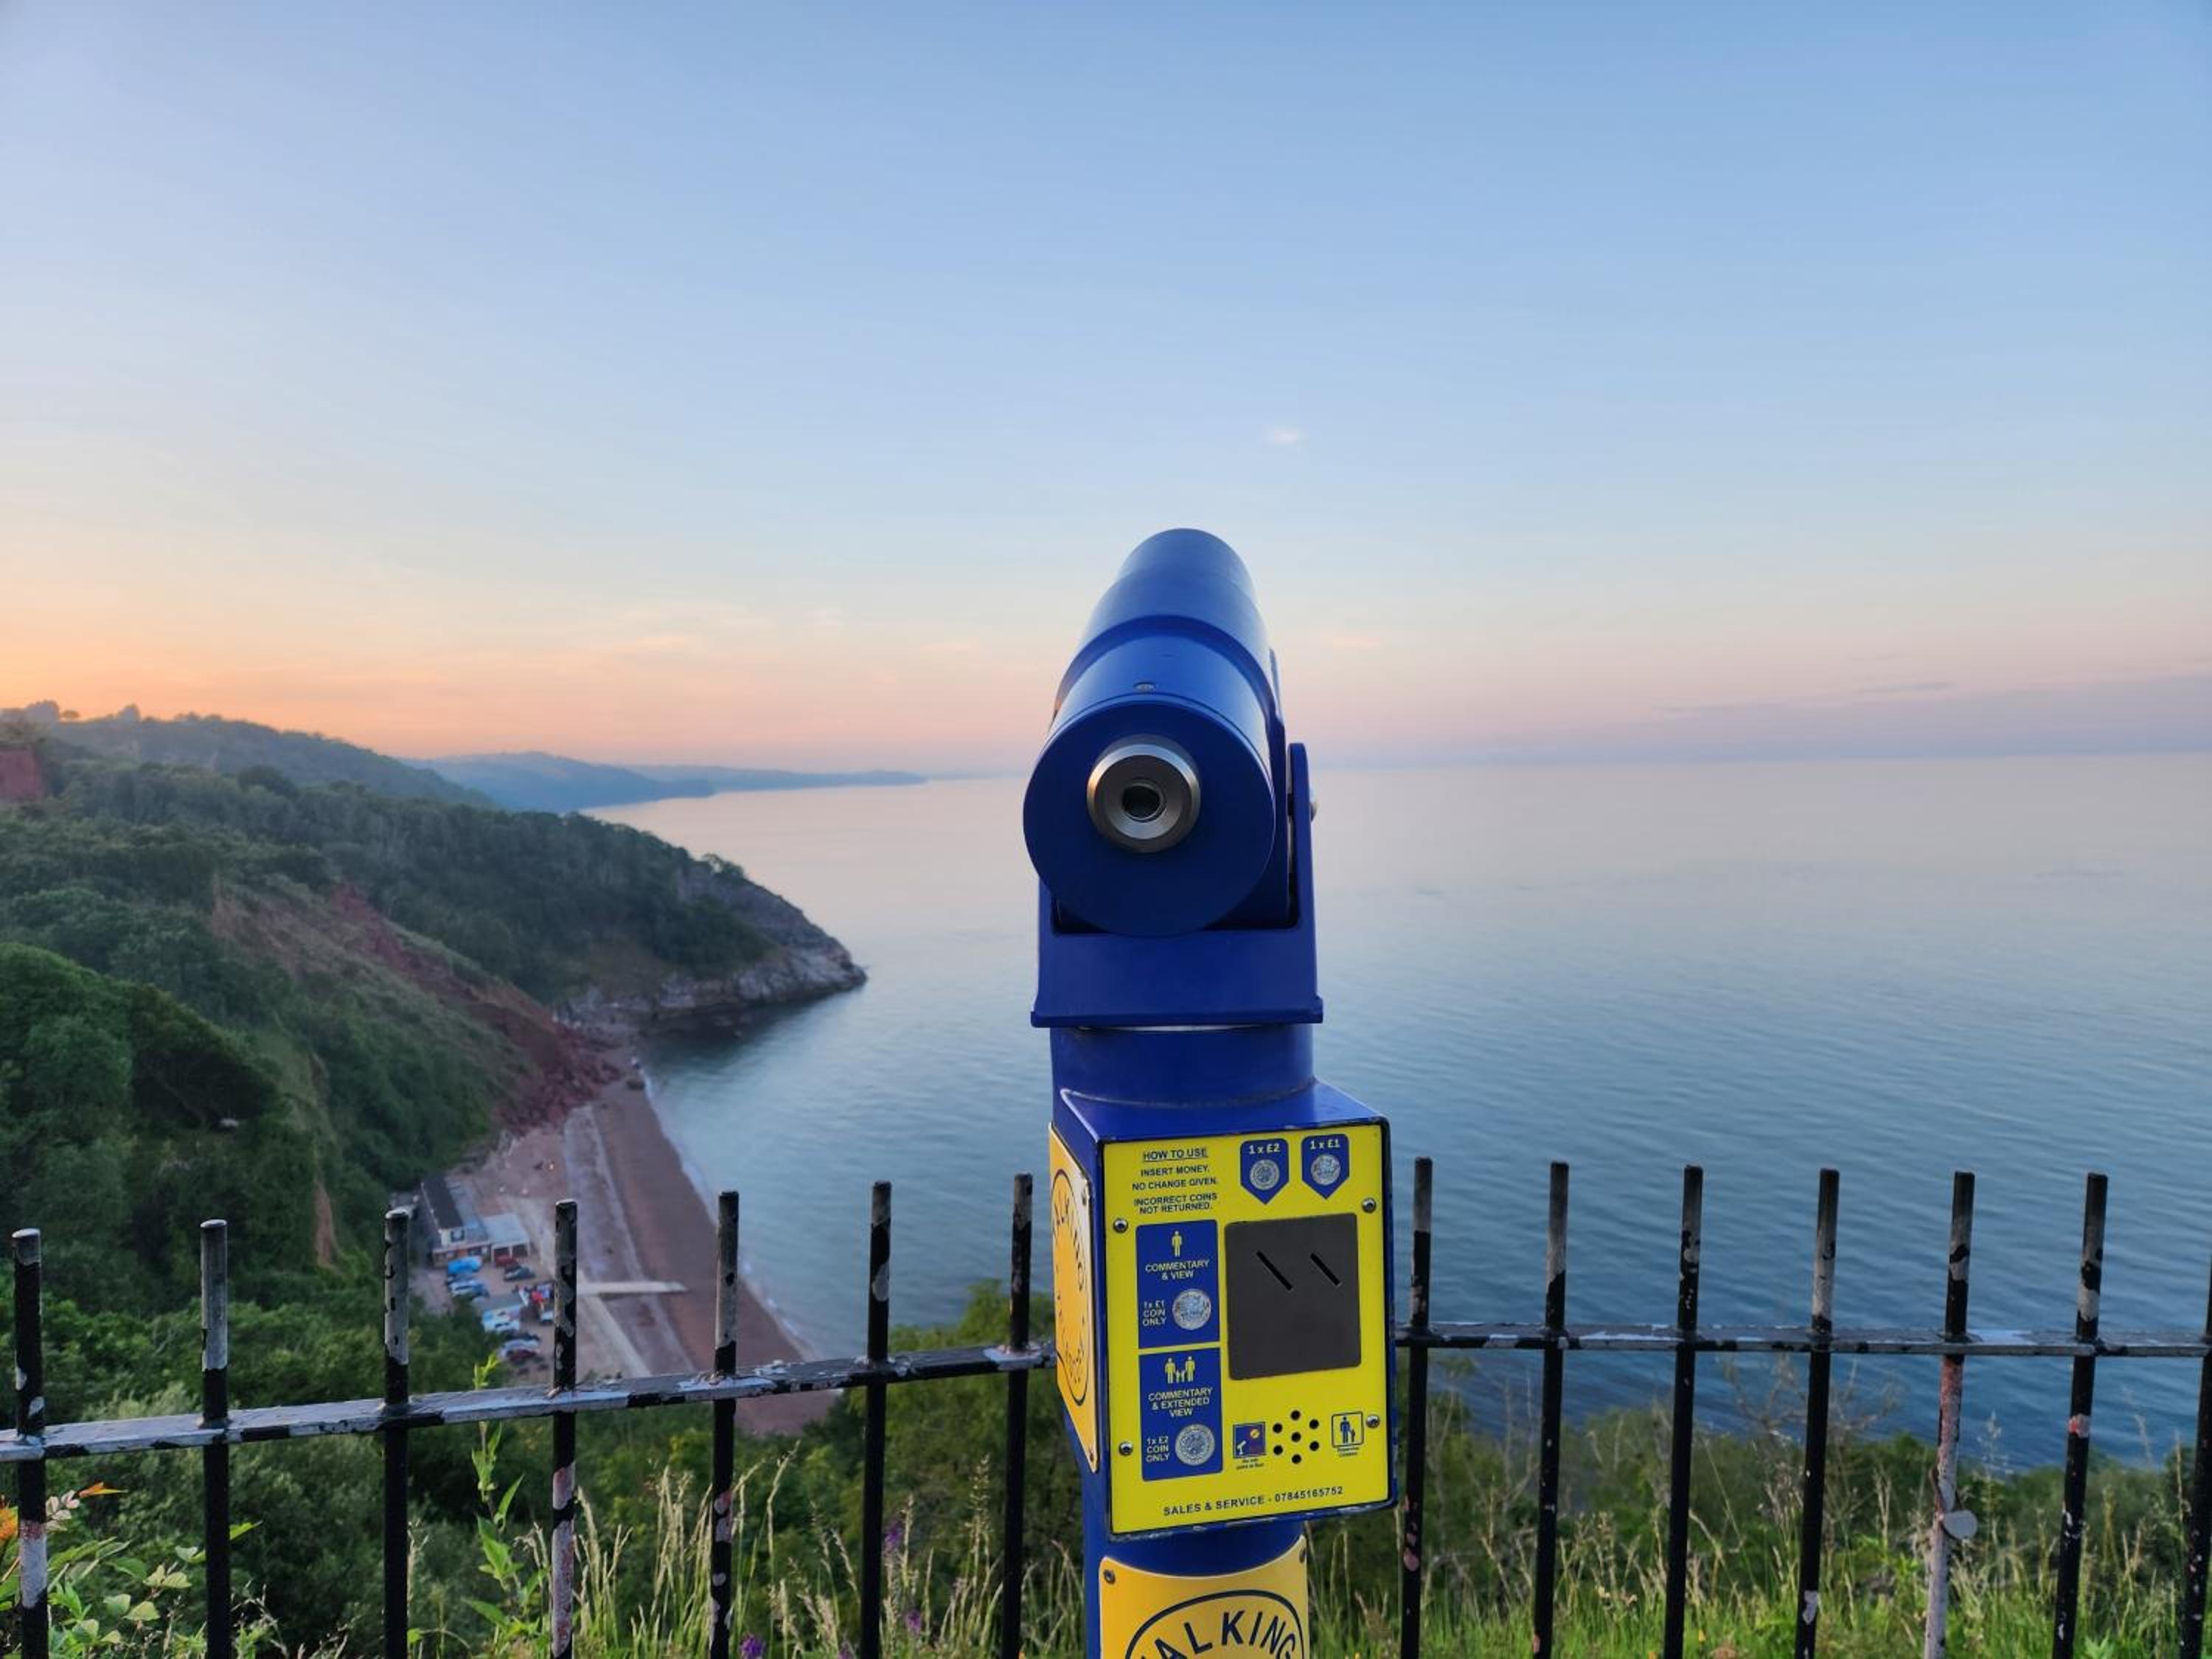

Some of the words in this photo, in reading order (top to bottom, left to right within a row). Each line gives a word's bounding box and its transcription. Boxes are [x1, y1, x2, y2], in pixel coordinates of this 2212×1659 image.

[1143, 1150, 1168, 1161] HOW
[1170, 1150, 1185, 1158] TO
[1186, 1148, 1208, 1158] USE
[1141, 1167, 1174, 1177] INSERT
[1133, 1182, 1146, 1191] NO
[1148, 1179, 1186, 1189] CHANGE
[1133, 1195, 1187, 1206] INCORRECT
[1189, 1192, 1218, 1202] COINS
[1139, 1206, 1158, 1214] NOT
[1145, 1259, 1209, 1273] COMMENTARY
[1170, 1269, 1194, 1280] VIEW
[1142, 1308, 1166, 1318] COIN
[1142, 1316, 1167, 1326] ONLY
[1148, 1387, 1213, 1402] COMMENTARY
[1161, 1397, 1210, 1409] EXTENDED
[1169, 1407, 1194, 1417] VIEW
[1147, 1444, 1169, 1454] COIN
[1145, 1453, 1170, 1463] ONLY
[1164, 1503, 1202, 1516] SALES
[1204, 1502, 1212, 1511] &
[1215, 1495, 1265, 1509] SERVICE
[1141, 1610, 1295, 1659] ALKING
